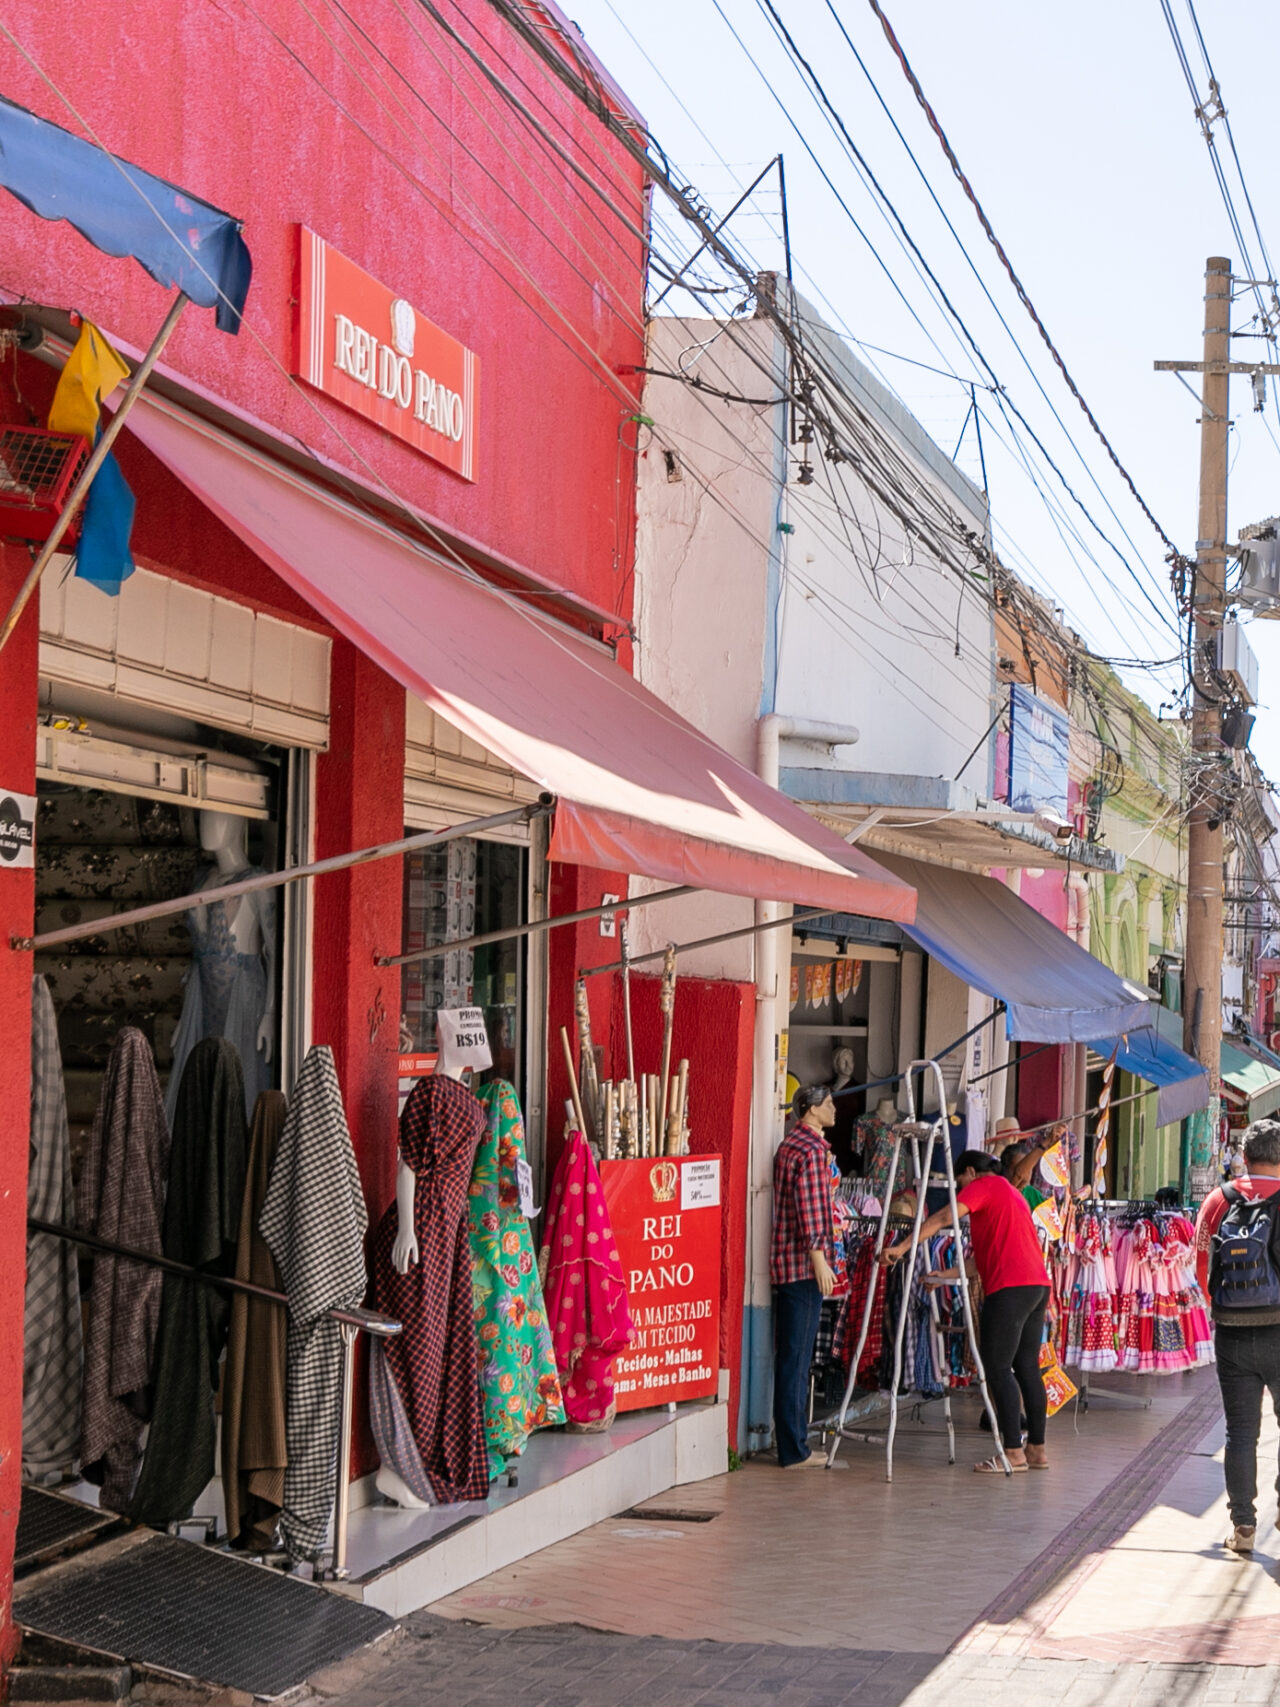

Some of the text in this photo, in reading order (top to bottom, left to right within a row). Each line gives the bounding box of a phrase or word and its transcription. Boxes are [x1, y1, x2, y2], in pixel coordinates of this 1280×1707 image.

[334, 314, 463, 442] REI DO PANO
[642, 1214, 682, 1241] REI
[651, 1244, 674, 1261] DO
[629, 1262, 694, 1293] PANO
[645, 1299, 712, 1326] MAJESTADE
[650, 1323, 696, 1348] TECIDO
[616, 1347, 702, 1374] Tecidos Malhas
[613, 1364, 712, 1394] ama Mesa e Banho
